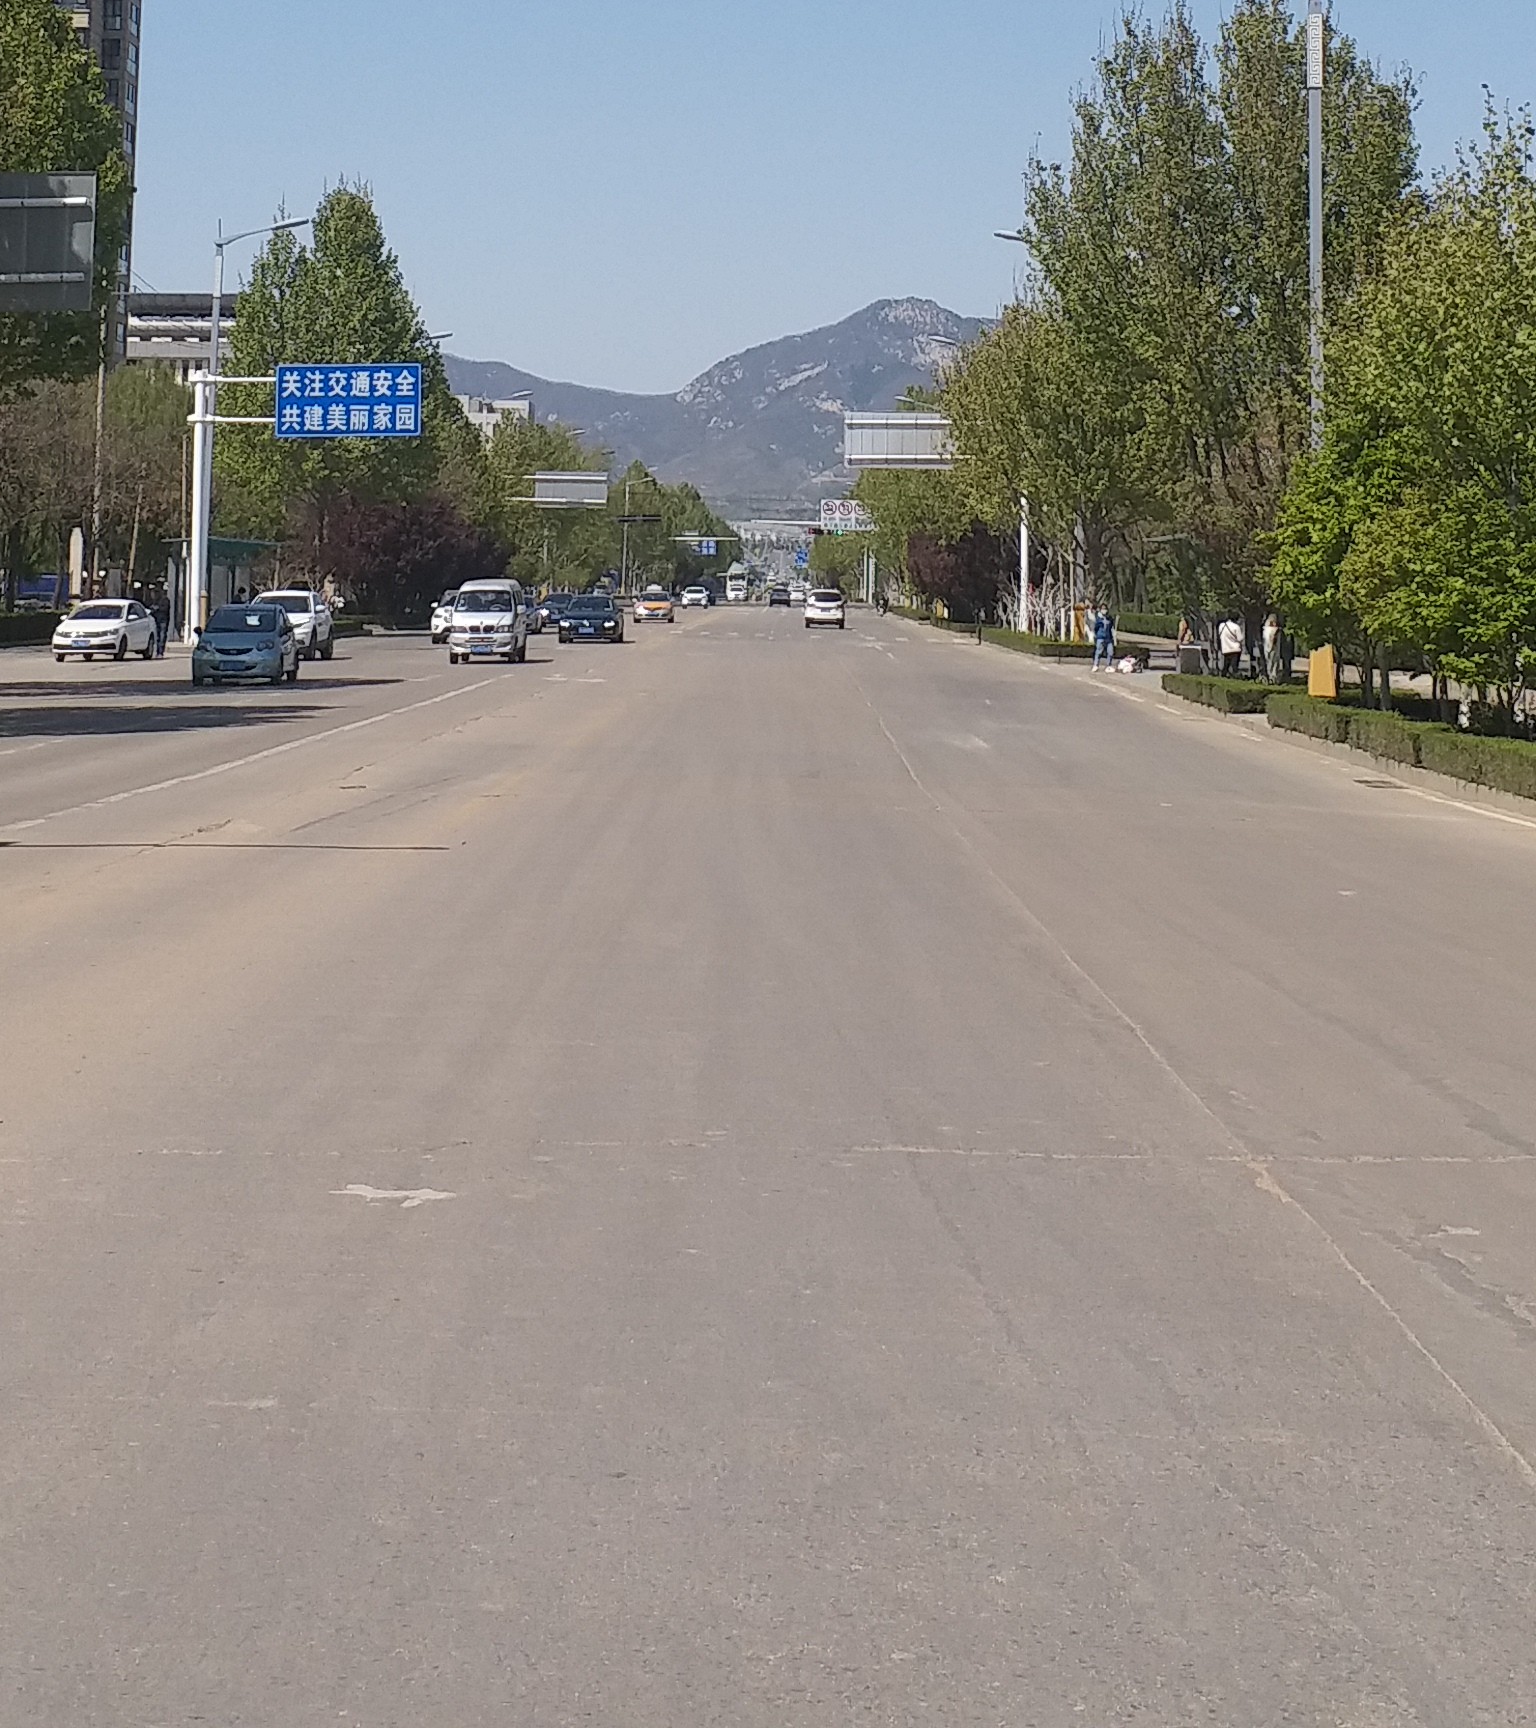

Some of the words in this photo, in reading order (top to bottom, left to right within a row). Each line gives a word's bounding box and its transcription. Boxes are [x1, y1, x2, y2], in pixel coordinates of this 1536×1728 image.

[280, 369, 416, 398] 关注交通安全
[280, 403, 416, 431] 共建美丽家园
